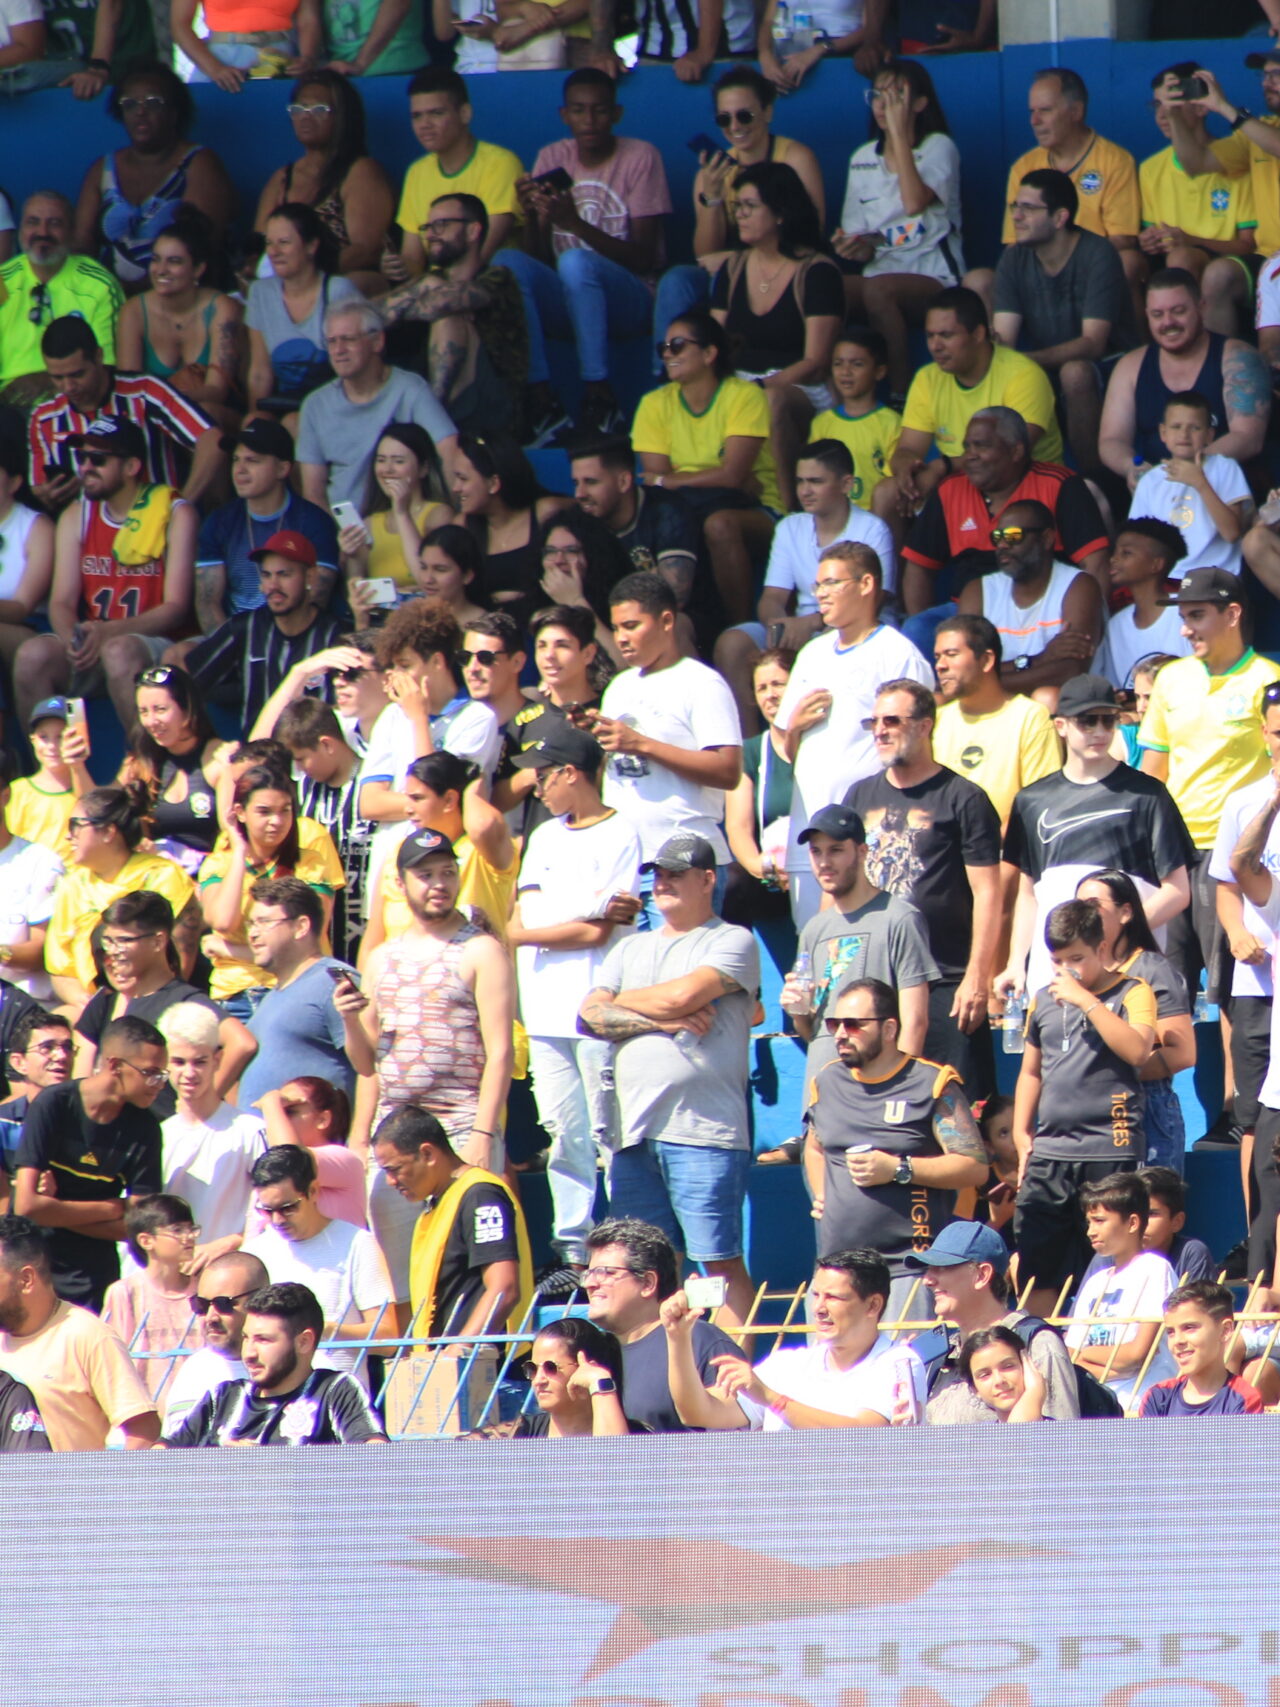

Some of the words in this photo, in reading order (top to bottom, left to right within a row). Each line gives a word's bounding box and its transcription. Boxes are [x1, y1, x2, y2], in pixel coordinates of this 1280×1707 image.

[92, 587, 140, 621] 11
[884, 1101, 907, 1123] U
[1111, 1092, 1130, 1148] TIGRES
[911, 1189, 932, 1253] TIGRS
